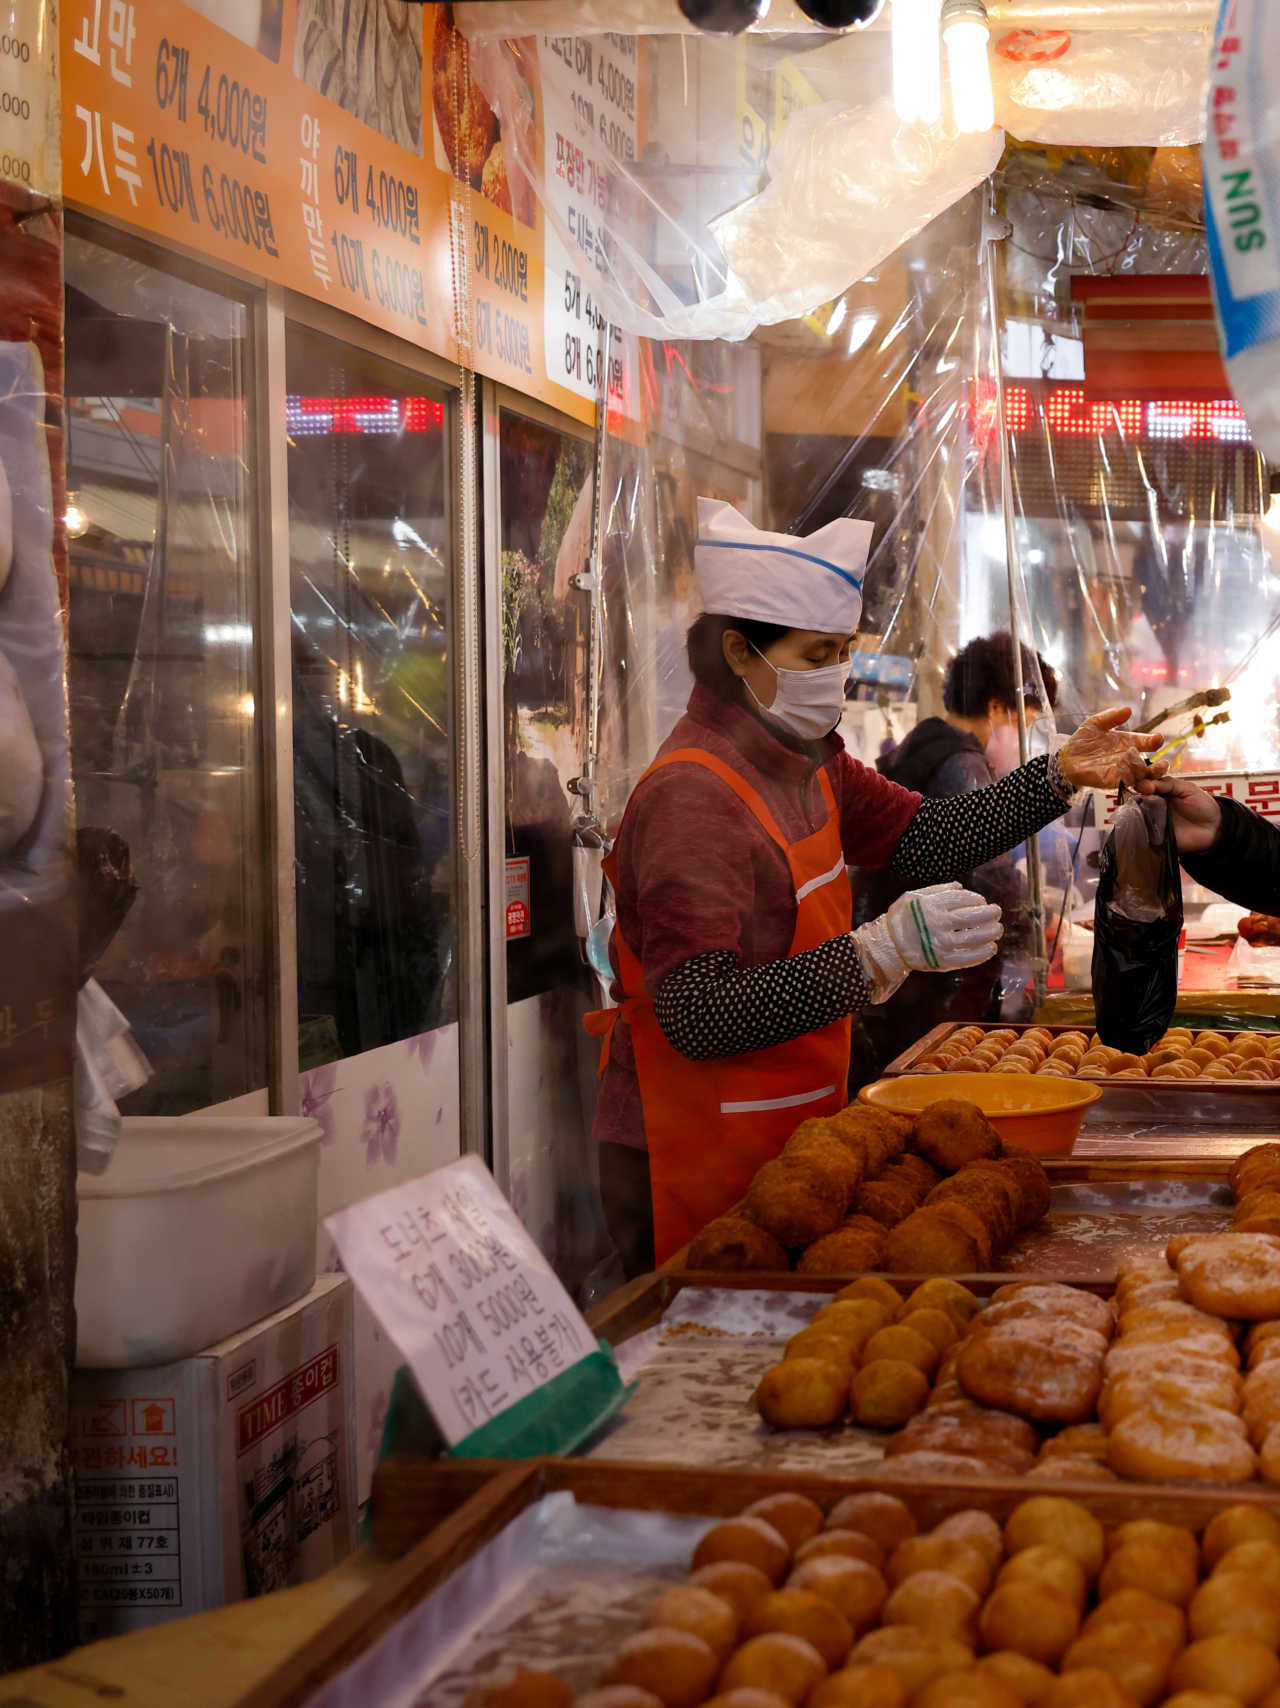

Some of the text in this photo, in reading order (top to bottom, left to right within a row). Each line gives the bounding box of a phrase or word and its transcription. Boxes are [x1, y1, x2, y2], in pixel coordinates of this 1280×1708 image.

[155, 37, 190, 124] 6개
[197, 64, 267, 165] 4,000원
[147, 136, 280, 259] 10개 6,000원
[300, 112, 334, 292] 야끼만두
[333, 144, 421, 245] 6개 4,000원
[1220, 168, 1266, 254] SUN
[331, 230, 371, 301] 10개
[372, 249, 428, 327] 6,000원
[474, 220, 489, 280] 3개
[493, 234, 529, 303] 2,000원
[563, 270, 581, 321] 5개
[476, 297, 492, 354] 8개
[564, 331, 623, 401] 8개 6,00원
[410, 1234, 518, 1312] 6개 3000원
[433, 1272, 545, 1369] 10개 5000원
[243, 1389, 288, 1441] TIME
[291, 1354, 334, 1406] 종이컵
